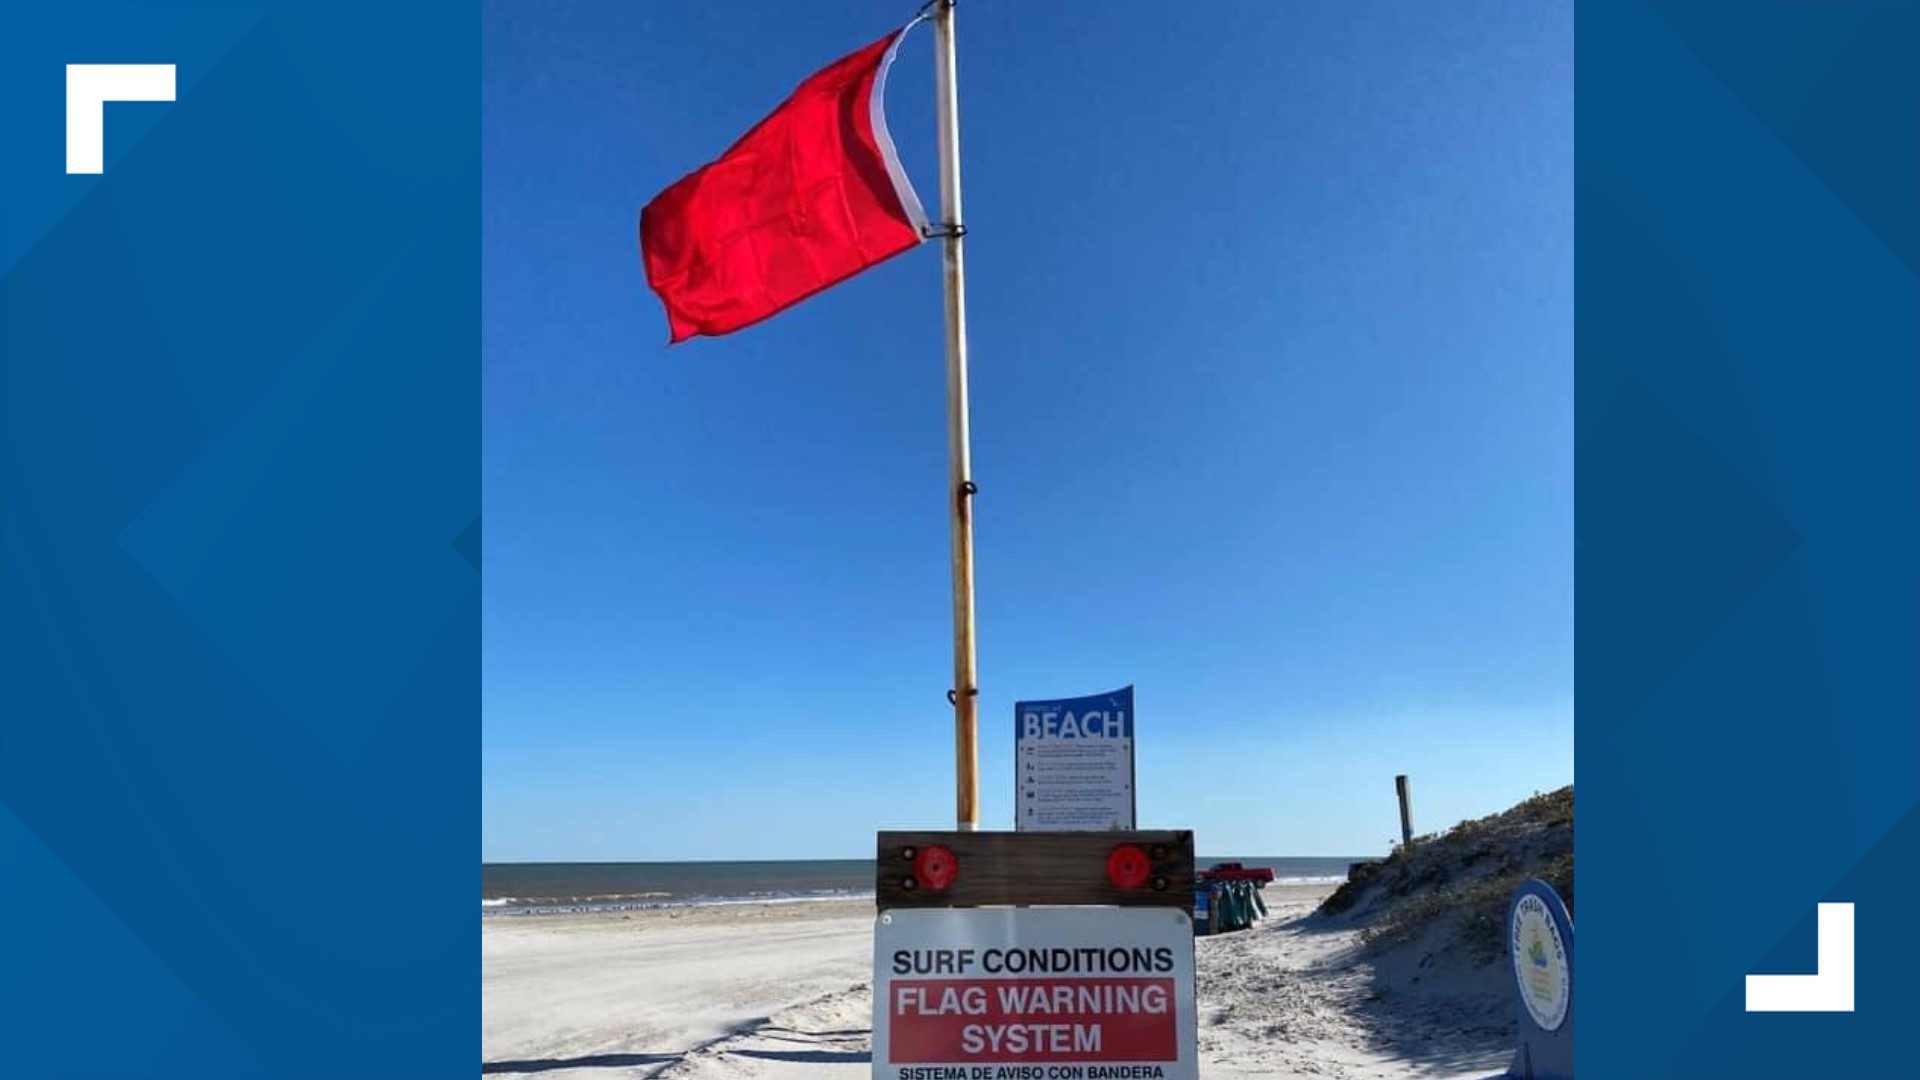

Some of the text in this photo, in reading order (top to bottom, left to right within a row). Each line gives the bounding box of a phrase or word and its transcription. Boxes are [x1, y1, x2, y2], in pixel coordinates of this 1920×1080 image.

[1023, 710, 1124, 740] BEACH
[892, 947, 1174, 974] SURF CONDITIONS
[897, 984, 1168, 1015] FLAG WARNING
[962, 1023, 1101, 1053] SYSTEM
[900, 1066, 1164, 1080] SISTEMA DE AVISO CON BANDERA
